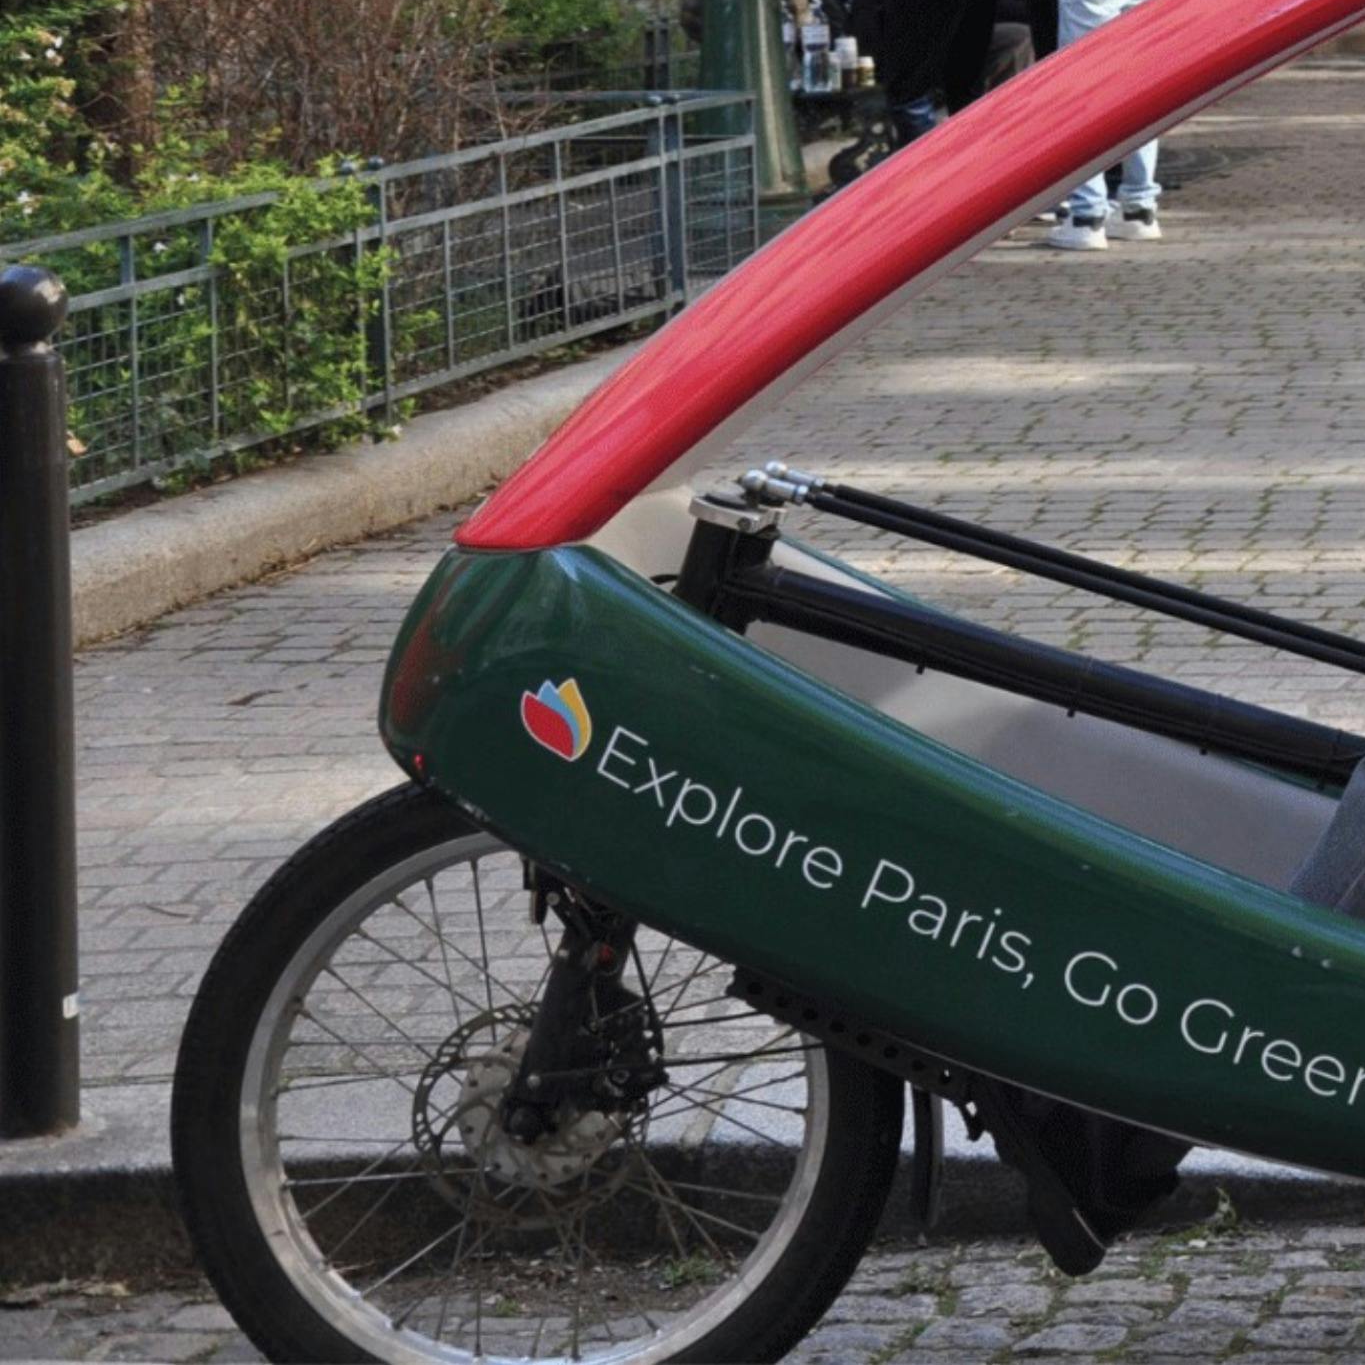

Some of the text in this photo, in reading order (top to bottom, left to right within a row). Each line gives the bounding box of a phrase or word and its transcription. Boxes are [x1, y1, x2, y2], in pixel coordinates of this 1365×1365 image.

[597, 725, 843, 889] Explore
[861, 859, 1034, 989] Paris,
[1064, 951, 1158, 1025] Go
